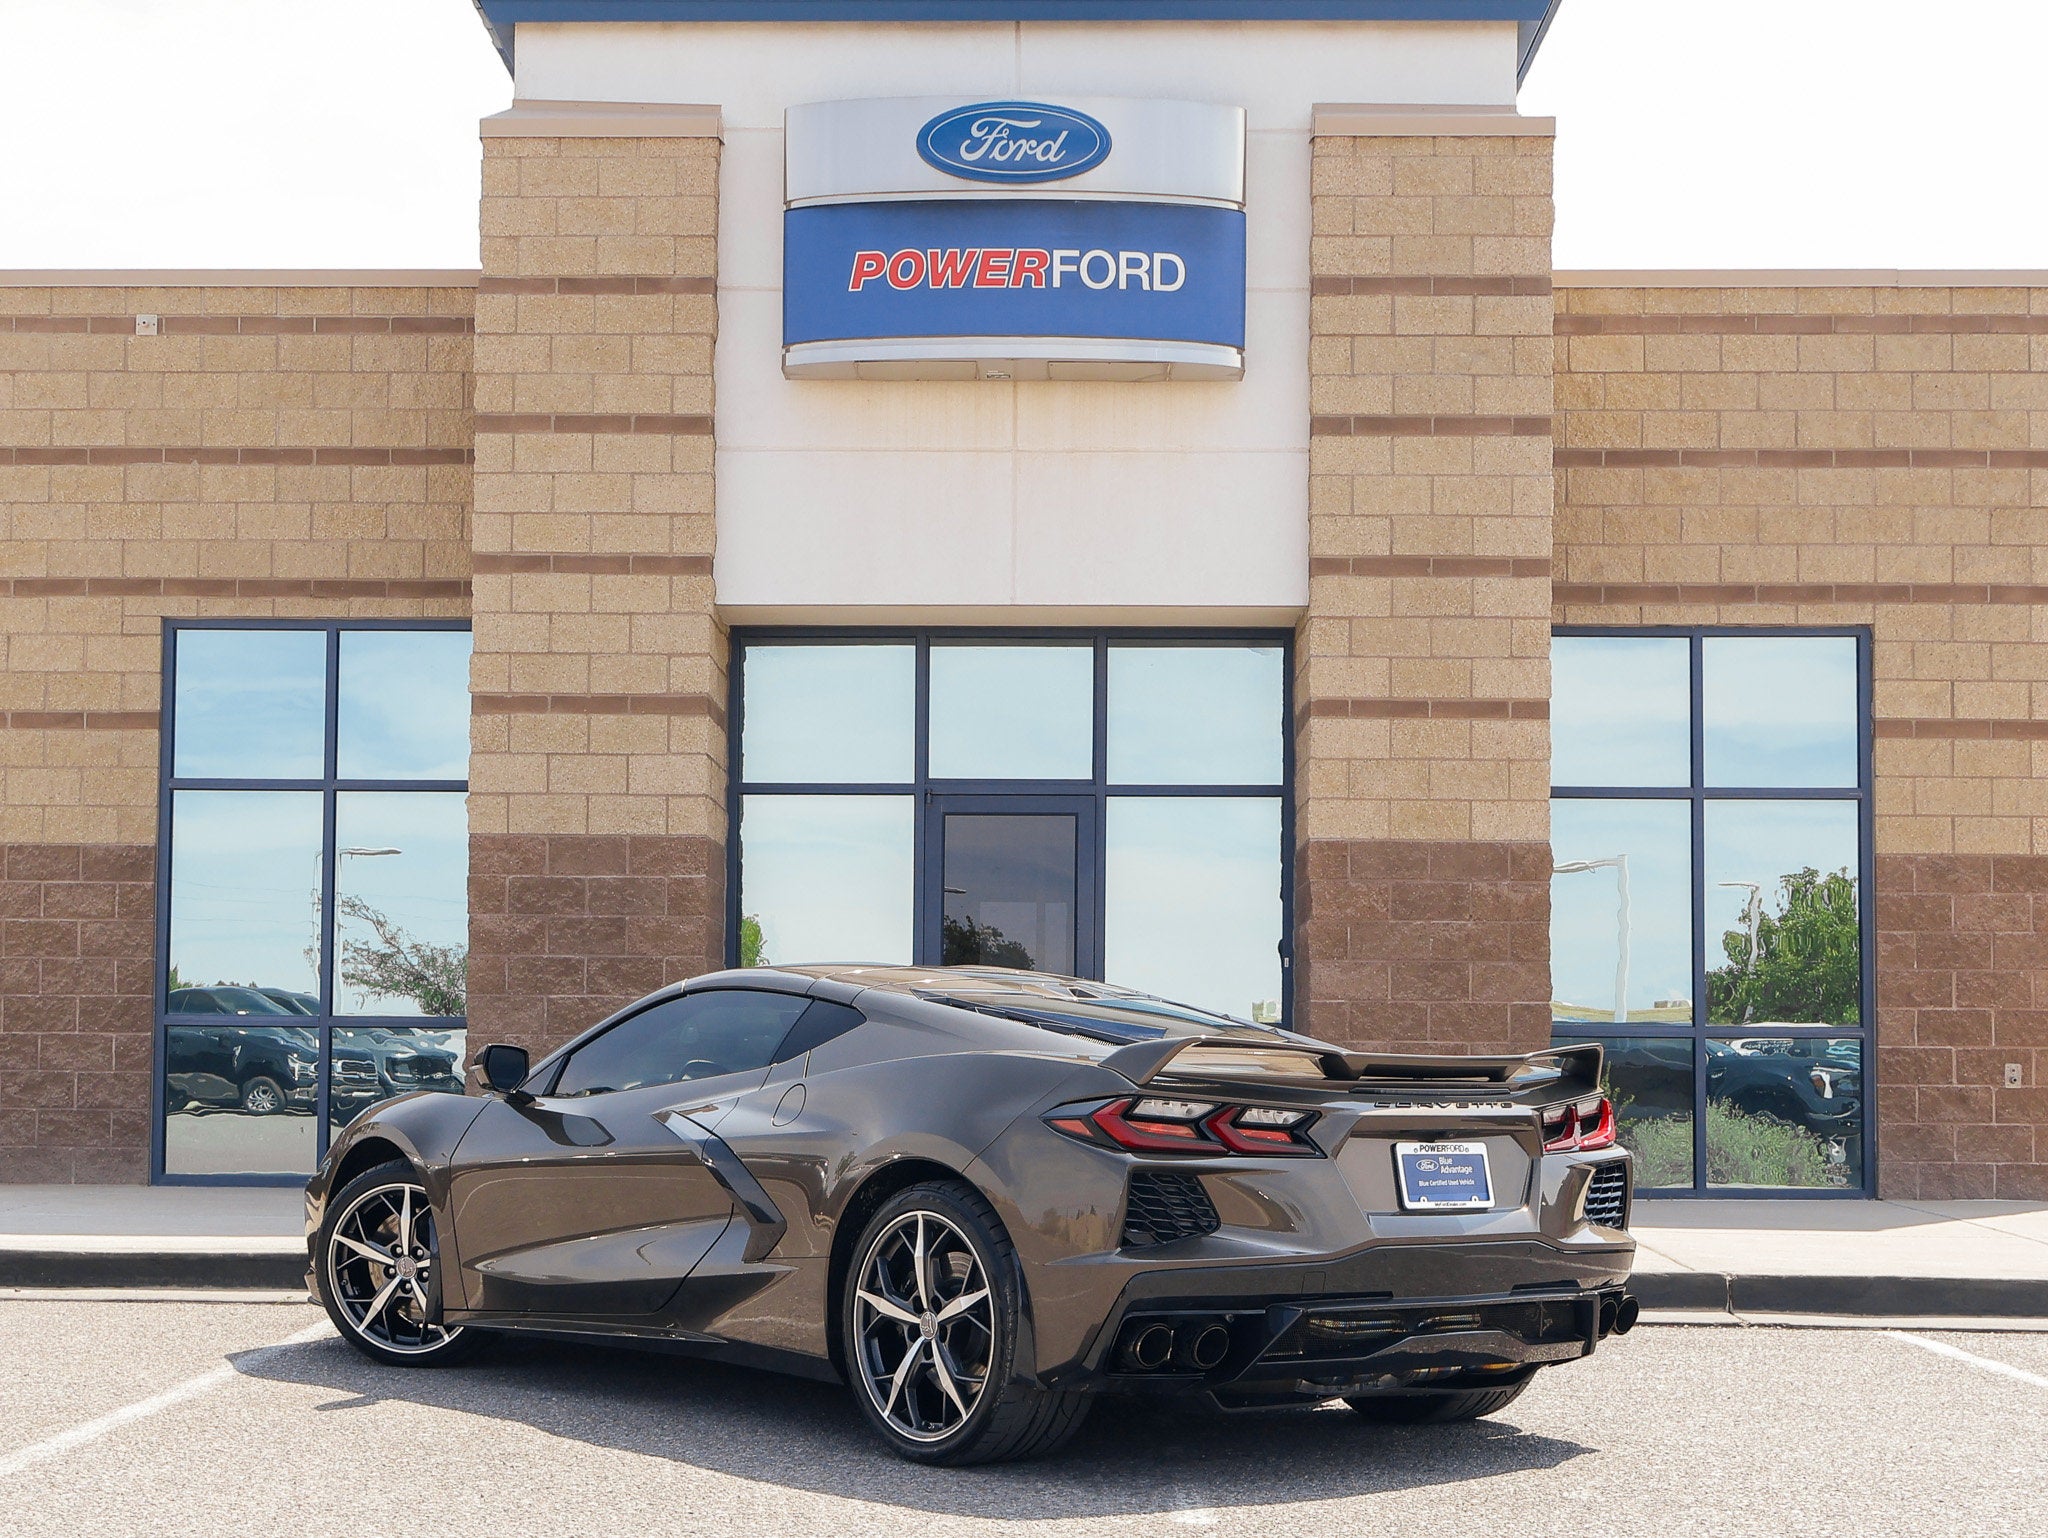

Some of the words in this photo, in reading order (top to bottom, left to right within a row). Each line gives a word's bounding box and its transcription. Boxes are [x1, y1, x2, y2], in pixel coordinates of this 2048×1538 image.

[959, 117, 1067, 163] Ford
[848, 248, 1187, 292] POWERFORD
[1419, 1144, 1465, 1153] POWERFORD
[1438, 1156, 1453, 1165] Blue
[1440, 1165, 1473, 1175] Advantage
